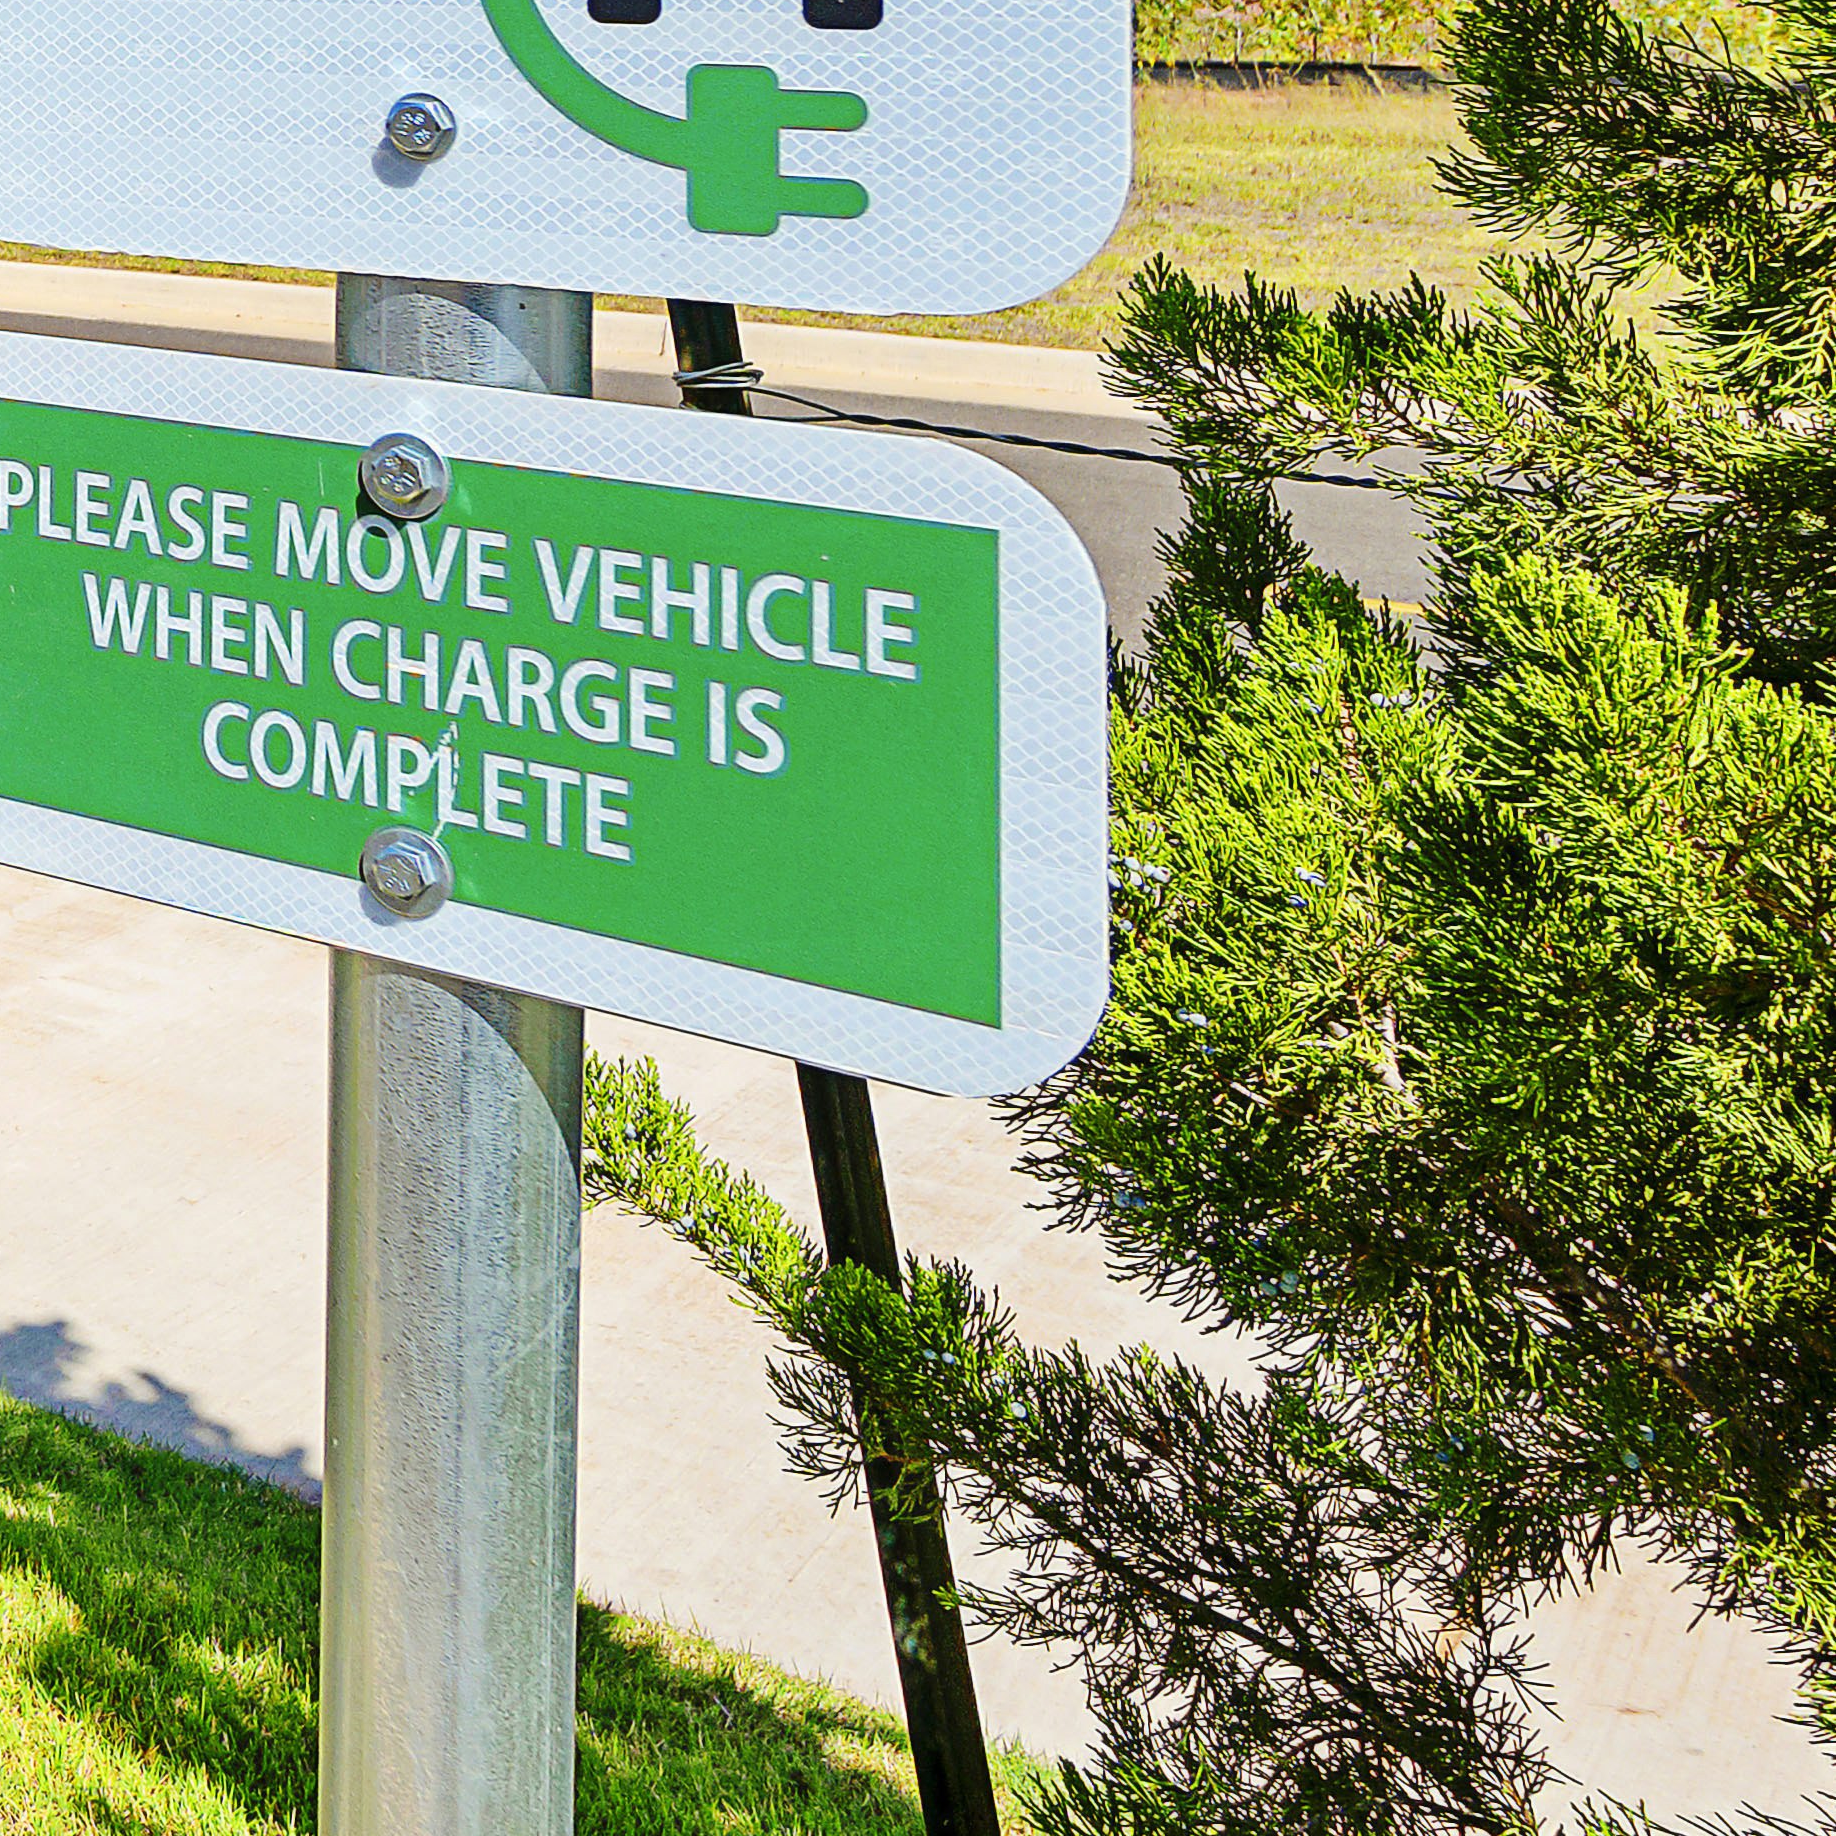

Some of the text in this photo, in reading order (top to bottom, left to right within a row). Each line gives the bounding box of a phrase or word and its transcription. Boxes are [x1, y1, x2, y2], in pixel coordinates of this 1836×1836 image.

[82, 572, 786, 774] WHEN CHARGE IS
[274, 500, 509, 613] MOVE
[534, 538, 918, 682] VEHICLE
[202, 701, 632, 863] COMPLETE
